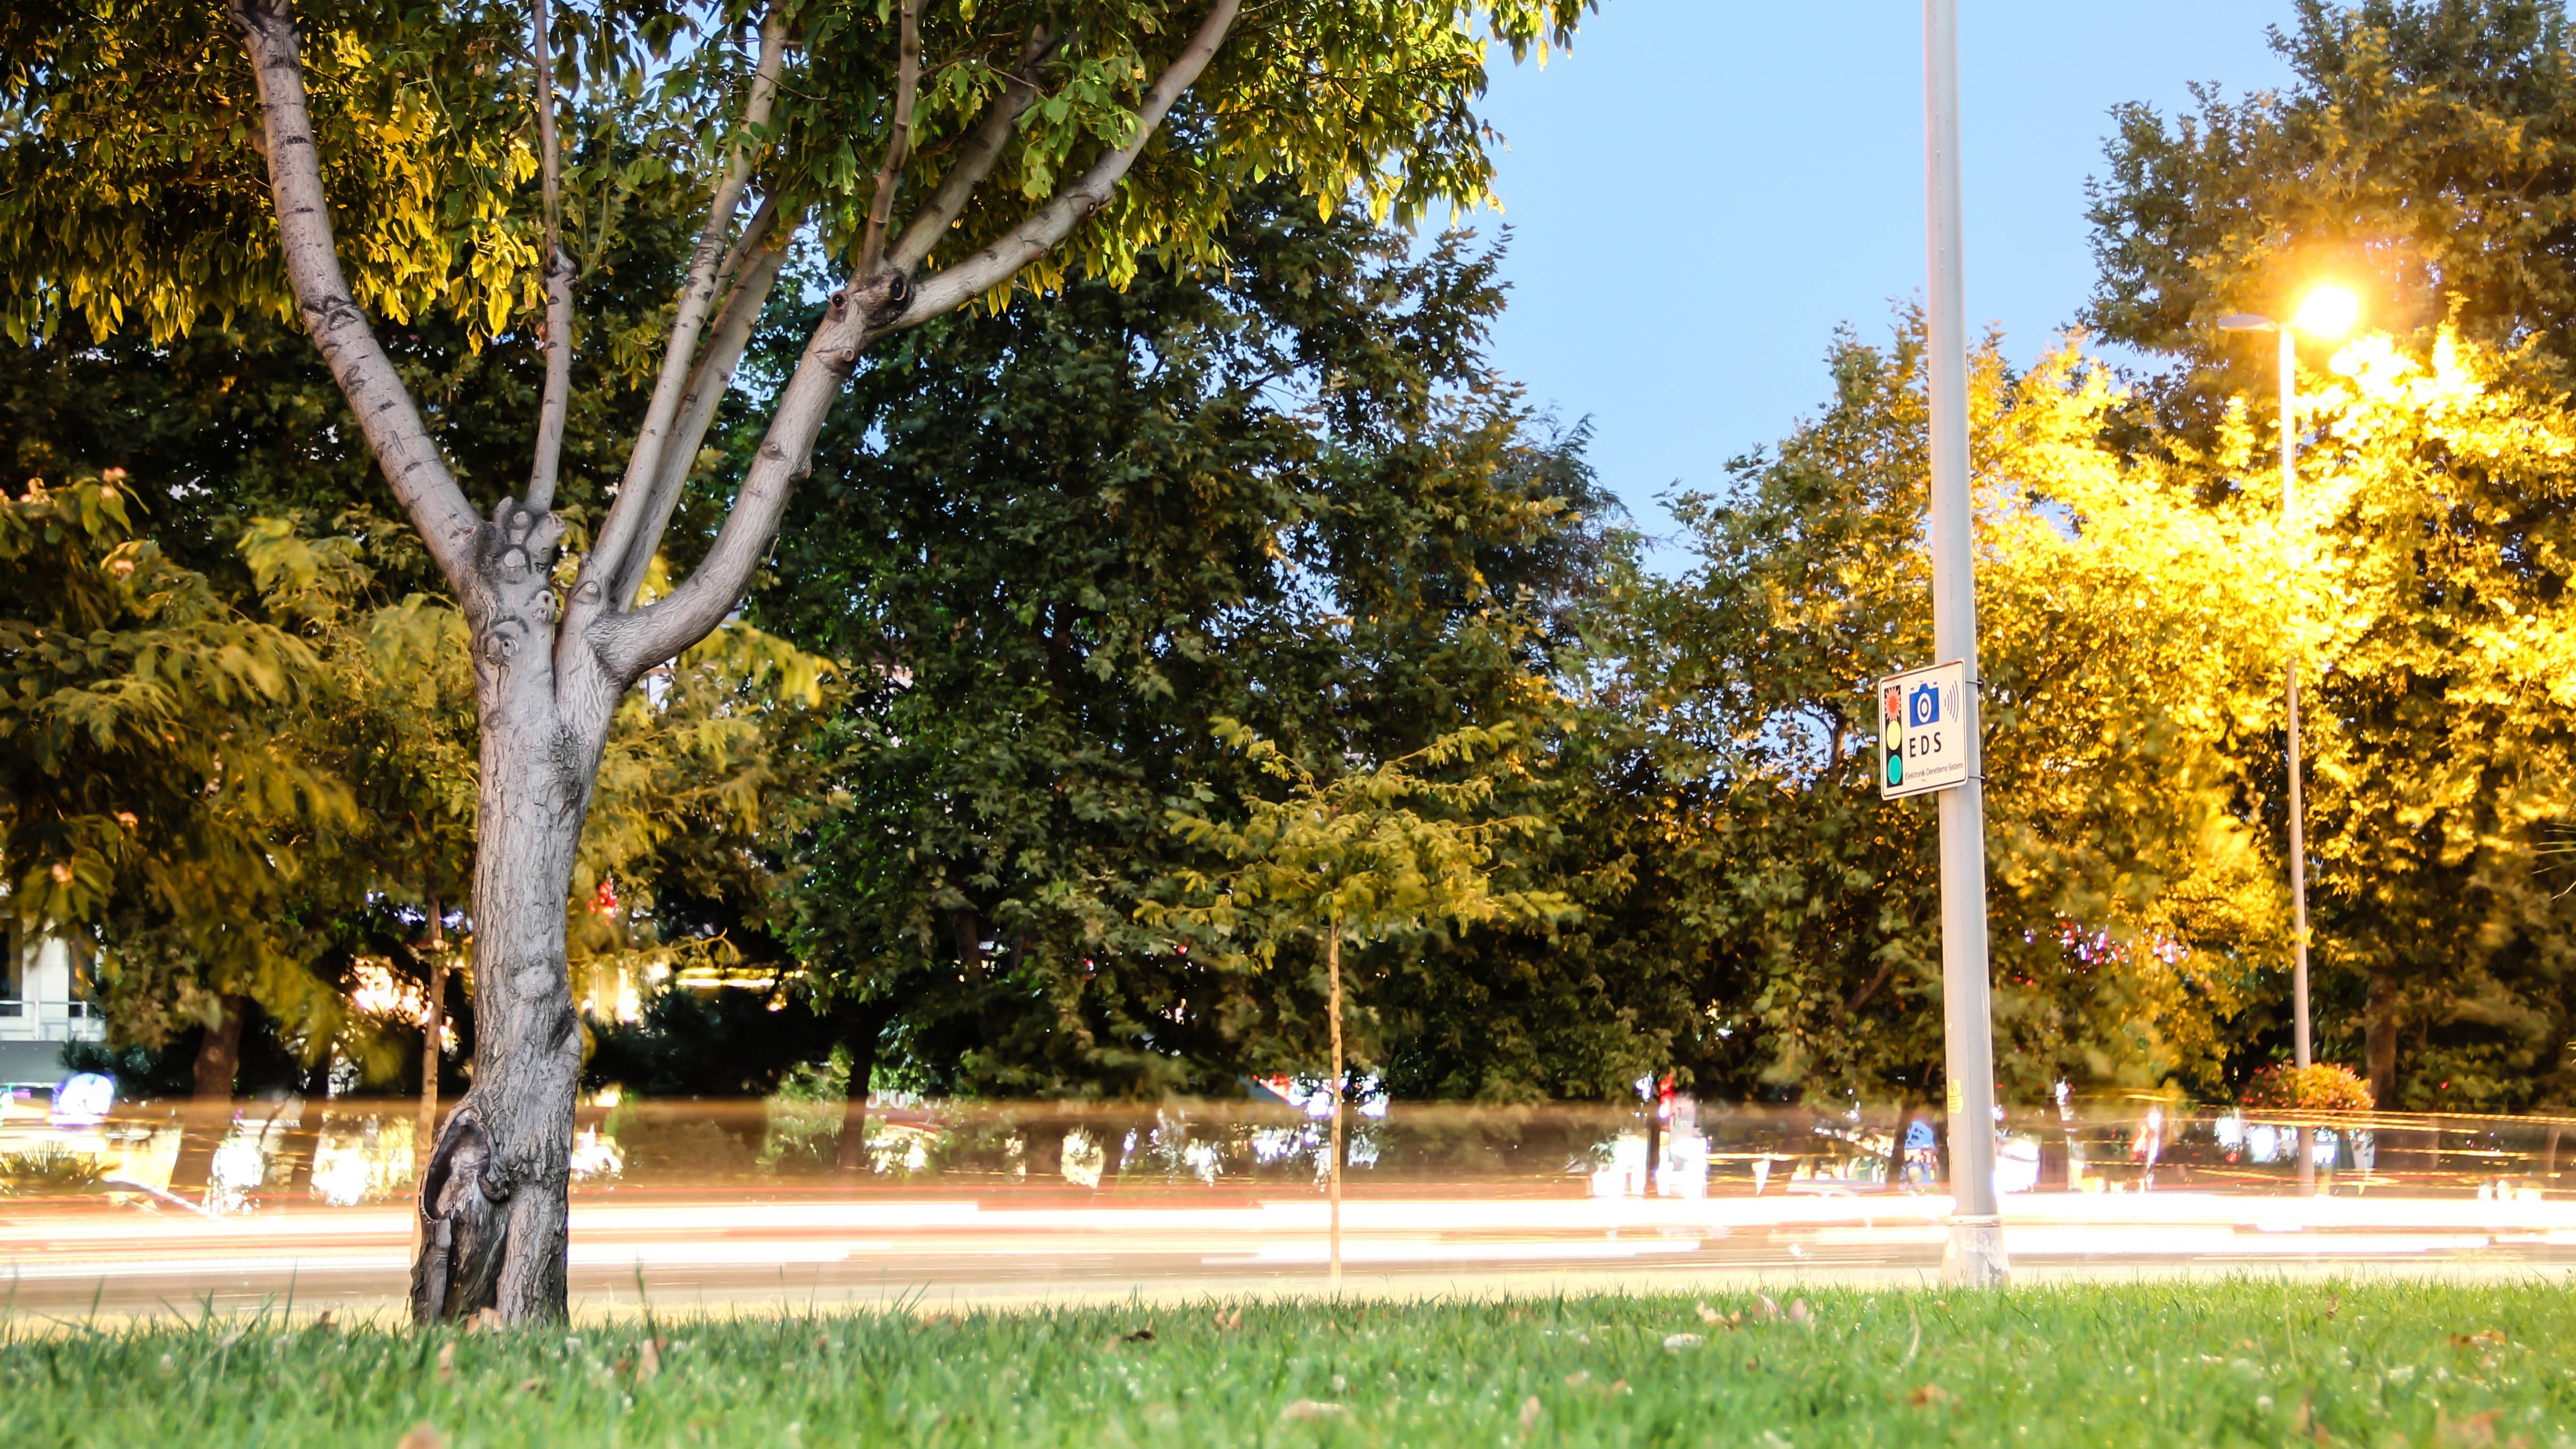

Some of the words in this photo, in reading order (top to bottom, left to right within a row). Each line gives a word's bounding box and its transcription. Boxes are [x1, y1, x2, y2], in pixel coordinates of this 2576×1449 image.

[1909, 731, 1942, 758] EDS
[1905, 769, 1925, 780] Elektronik
[1927, 766, 1947, 776] Denetleme
